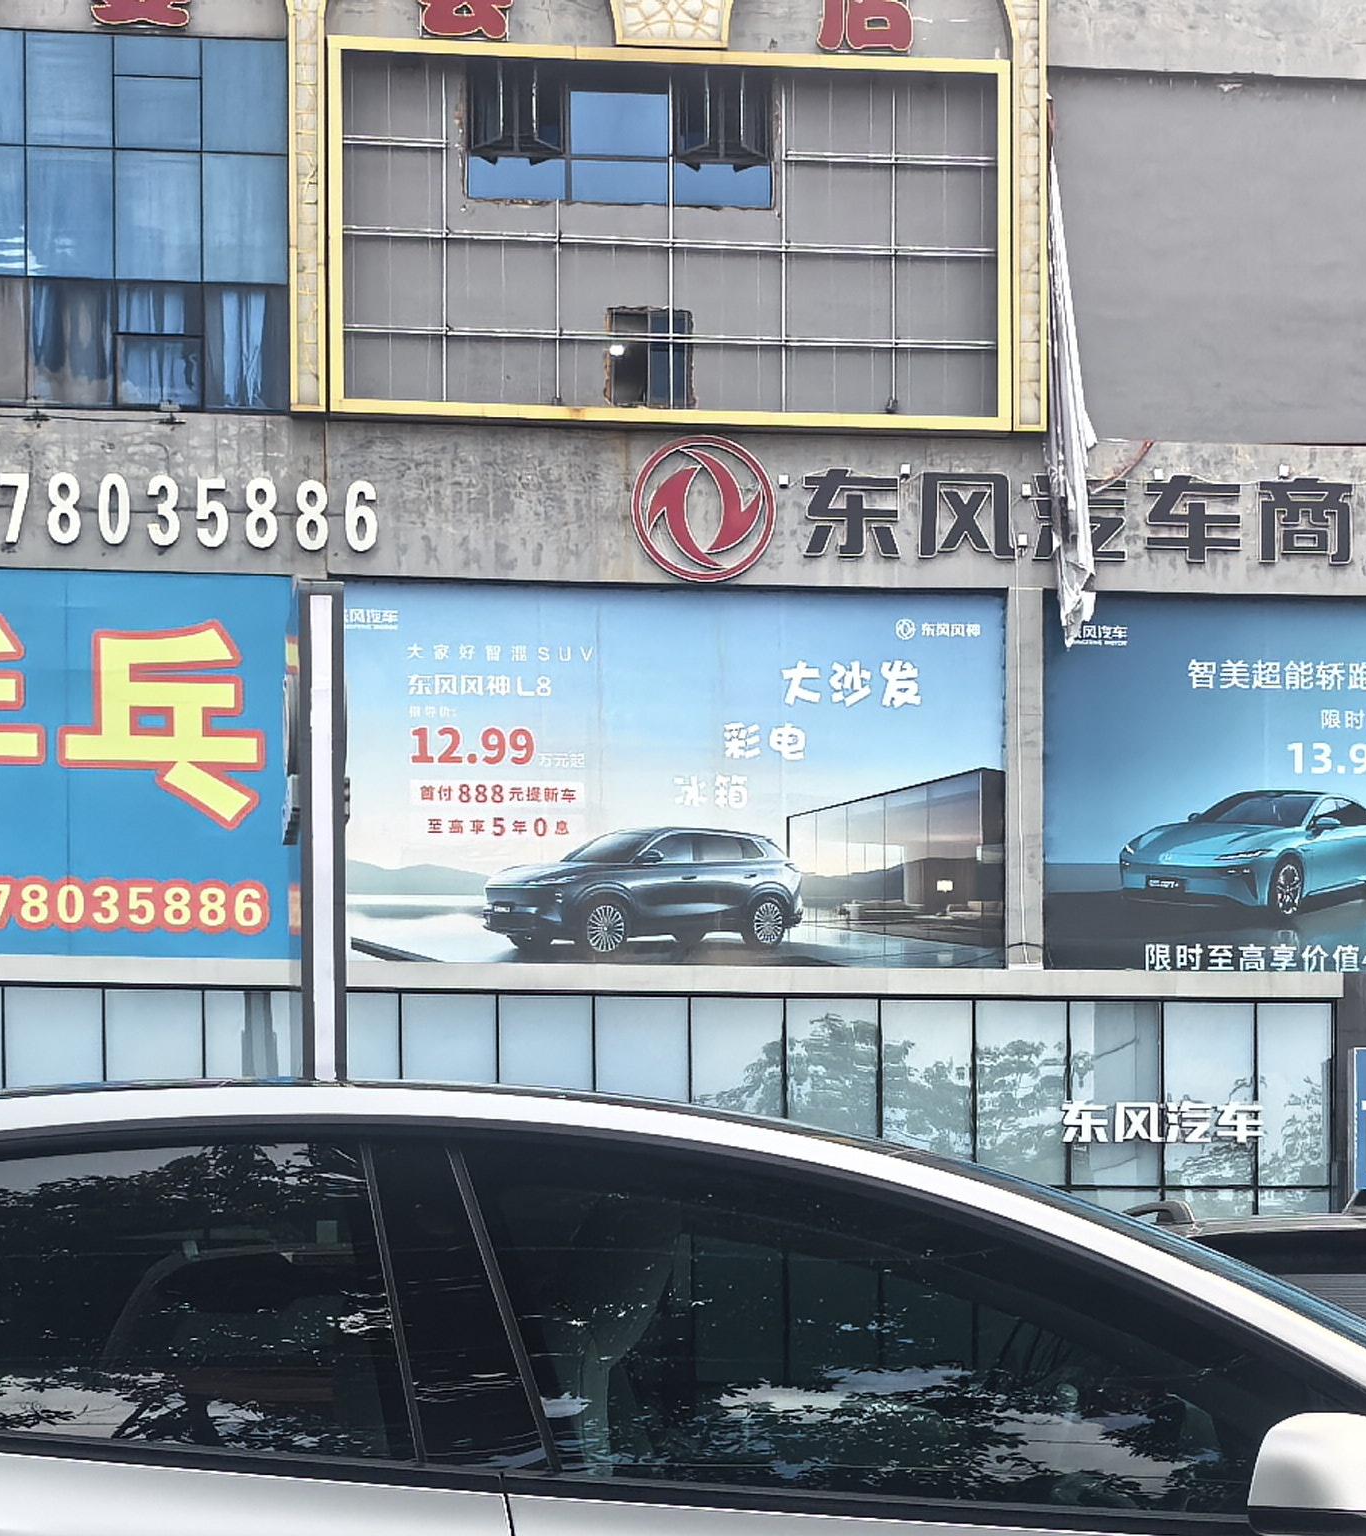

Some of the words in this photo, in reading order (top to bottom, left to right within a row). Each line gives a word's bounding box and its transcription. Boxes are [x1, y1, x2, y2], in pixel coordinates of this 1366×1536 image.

[781, 660, 922, 709] 大沙发
[723, 721, 807, 761] 彩电
[672, 770, 749, 810] 冰箱
[1060, 1099, 1265, 1144] 东风汽车
